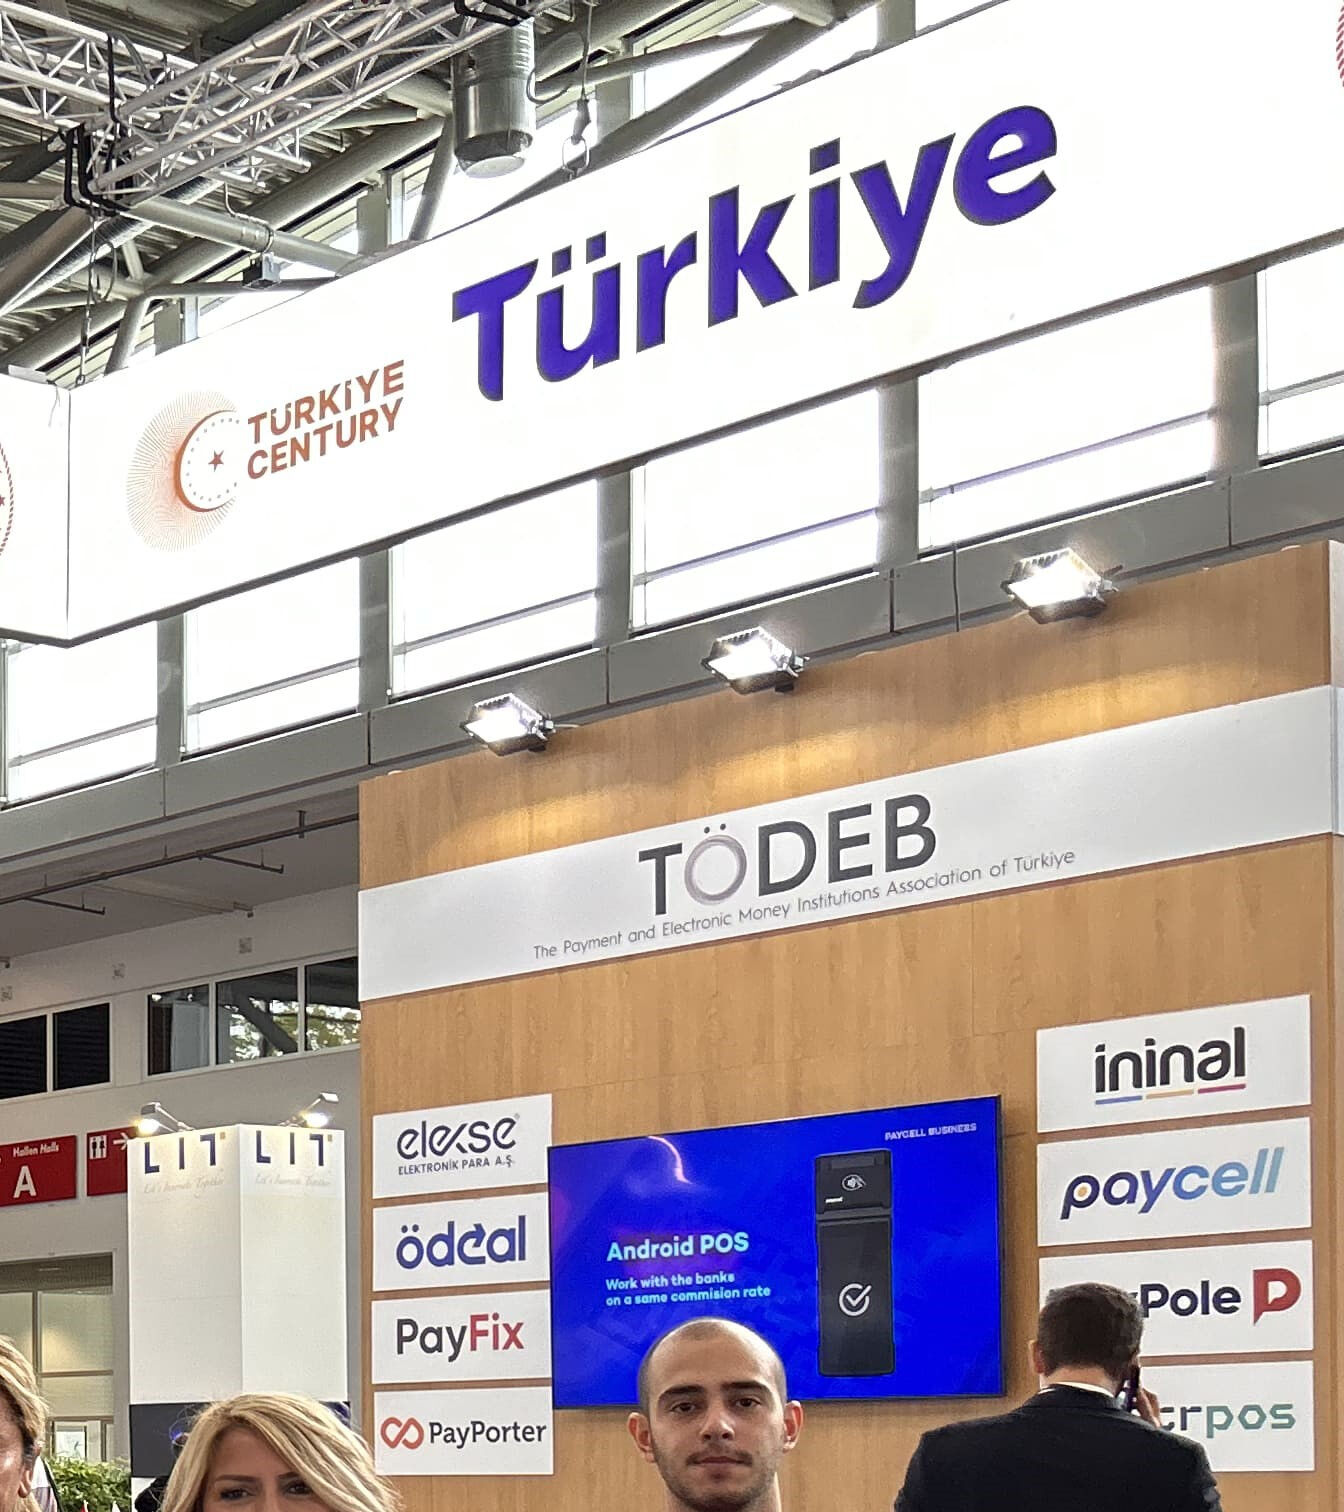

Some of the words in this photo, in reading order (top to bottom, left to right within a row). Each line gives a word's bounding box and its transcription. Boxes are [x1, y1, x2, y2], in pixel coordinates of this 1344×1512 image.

[451, 104, 1058, 403] Türkiye
[247, 397, 404, 480] CENTURY
[638, 794, 936, 916] TÖDEB
[533, 944, 557, 960] The
[563, 931, 622, 957] Payment
[628, 925, 655, 943] and
[662, 912, 732, 937] Electronic
[739, 901, 791, 924] Money
[798, 886, 880, 913] Institutions
[887, 866, 981, 897] Association
[989, 860, 1007, 878] of
[1095, 1026, 1246, 1093] ininal
[13, 1165, 37, 1199] A
[462, 1157, 490, 1169] PARA
[1060, 1146, 1285, 1220] paycell
[607, 1235, 694, 1262] Android
[700, 1231, 749, 1254] POS
[606, 1278, 638, 1290] Work
[641, 1276, 668, 1289] with
[671, 1273, 692, 1286] the
[696, 1271, 735, 1285] banks
[606, 1296, 621, 1306] on
[624, 1296, 632, 1305] a
[635, 1293, 667, 1304] same
[743, 1285, 771, 1298] rate
[1133, 1280, 1241, 1318] Pole
[396, 1312, 524, 1363] PayFix
[429, 1420, 547, 1449] PayPorter
